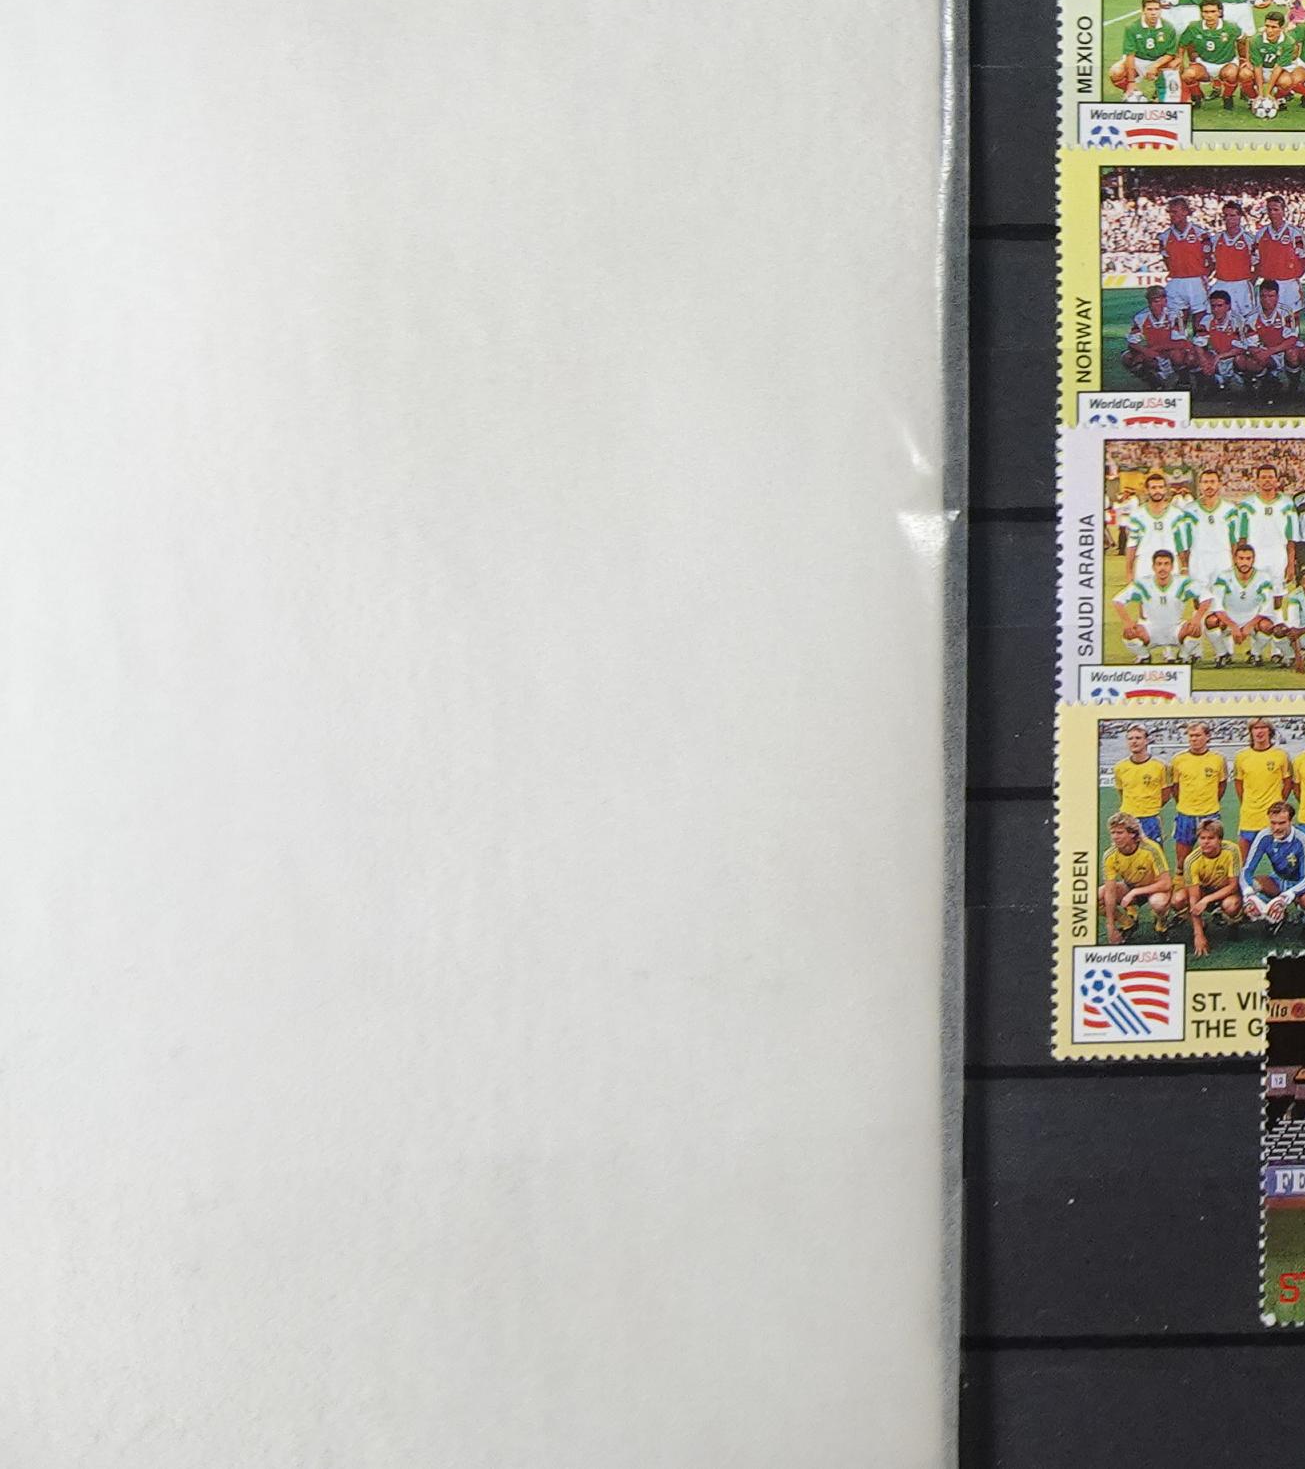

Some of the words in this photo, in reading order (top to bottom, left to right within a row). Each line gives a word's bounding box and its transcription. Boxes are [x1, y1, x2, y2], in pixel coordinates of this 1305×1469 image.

[1076, 15, 1093, 94] MEXICO
[1146, 38, 1155, 49] 8
[1206, 41, 1215, 51] 9
[1075, 297, 1093, 383] NORWAY
[1078, 514, 1095, 589] ARABIA
[1077, 596, 1094, 657] SAUDI
[1071, 851, 1089, 938] SWEDEN
[1191, 1019, 1237, 1038] THE
[1192, 993, 1226, 1012] ST.
